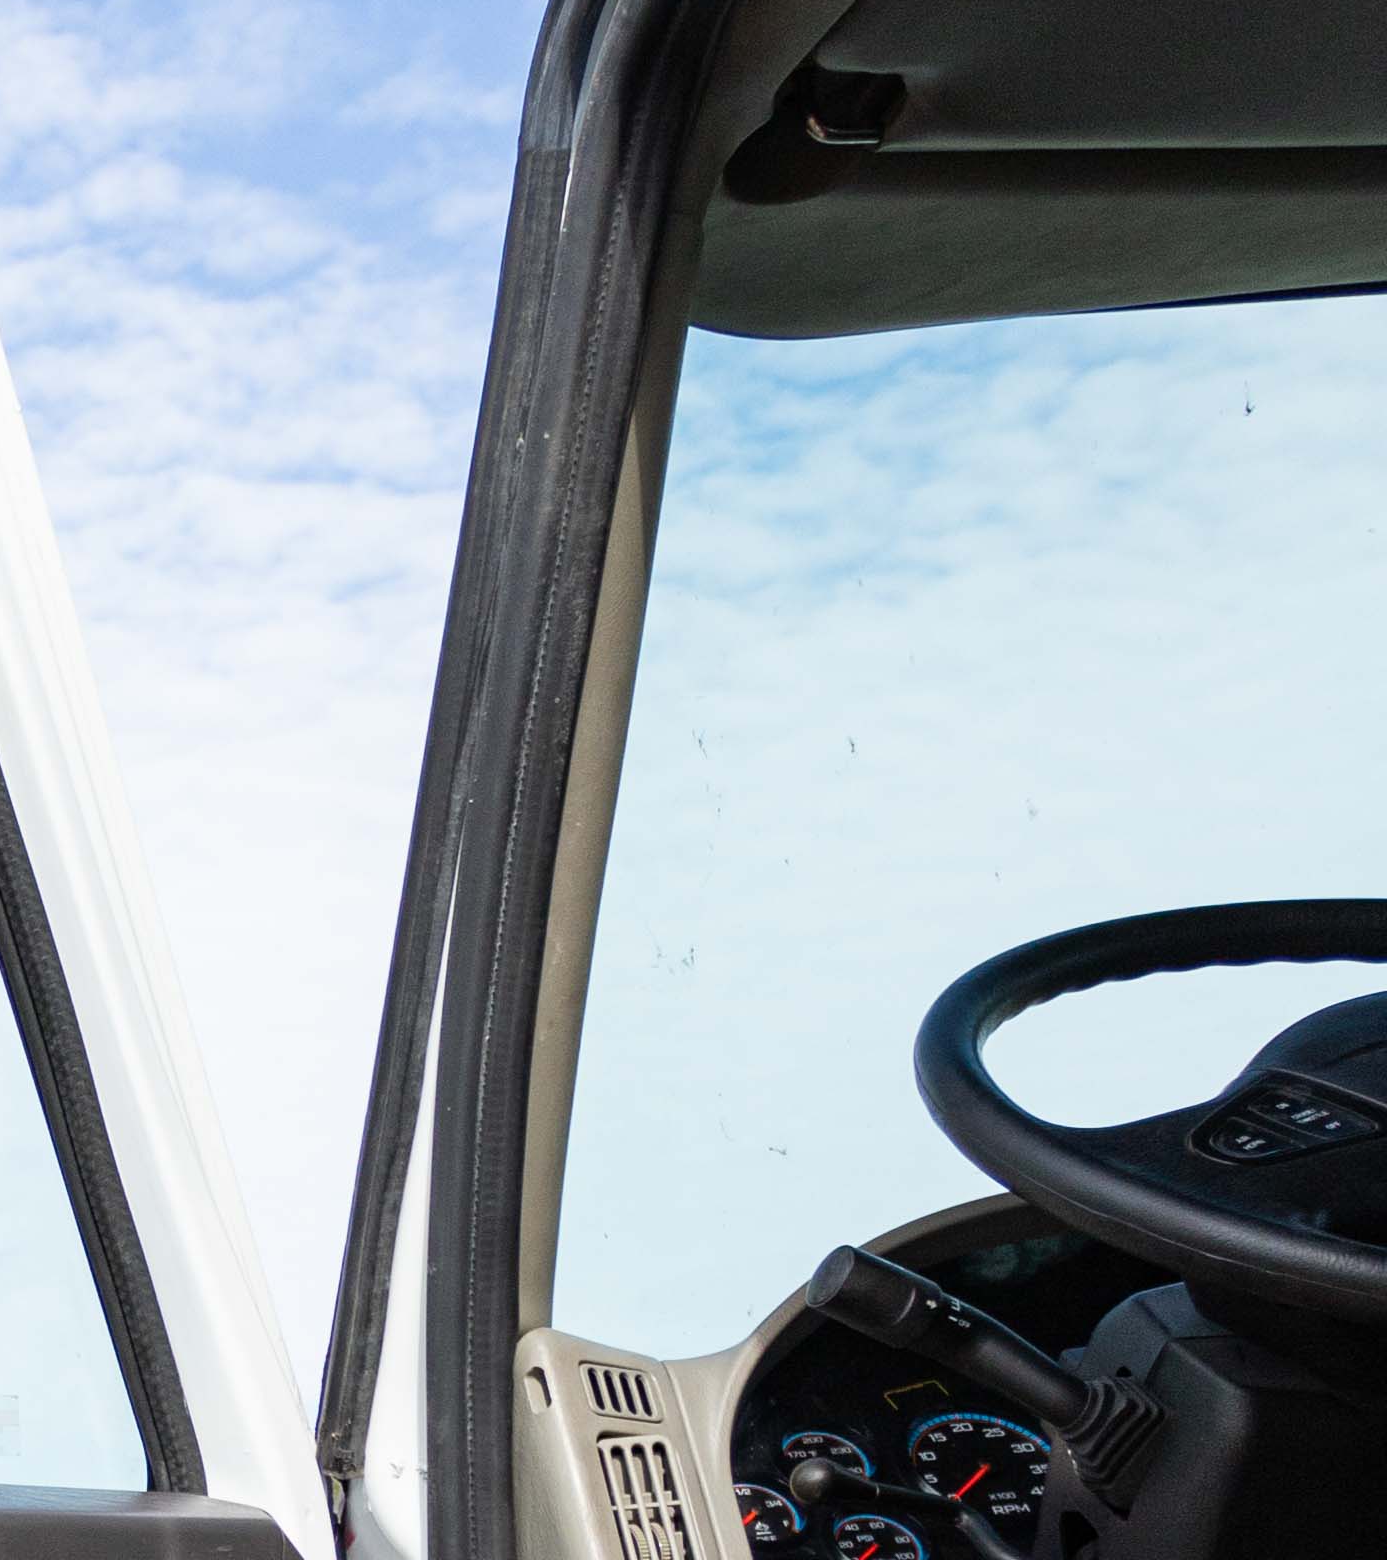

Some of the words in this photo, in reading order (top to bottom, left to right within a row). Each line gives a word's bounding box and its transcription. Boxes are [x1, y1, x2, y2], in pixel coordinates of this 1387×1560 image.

[950, 1422, 974, 1432] 20
[982, 1427, 1005, 1438] 25
[802, 1436, 823, 1444] 200
[928, 1432, 947, 1443] 15
[830, 1447, 852, 1455] 230
[1010, 1442, 1036, 1454] 30
[786, 1450, 806, 1459] 170
[918, 1451, 937, 1461] 10
[924, 1474, 938, 1484] 5
[735, 1487, 751, 1496] 1/2
[1030, 1485, 1045, 1496] 4
[765, 1500, 783, 1508] 3/4
[991, 1503, 1031, 1515] RPM
[844, 1523, 860, 1531] 40
[869, 1521, 885, 1530] 60
[894, 1535, 910, 1544] 80
[838, 1541, 855, 1549] 20
[895, 1552, 915, 1560] 100
